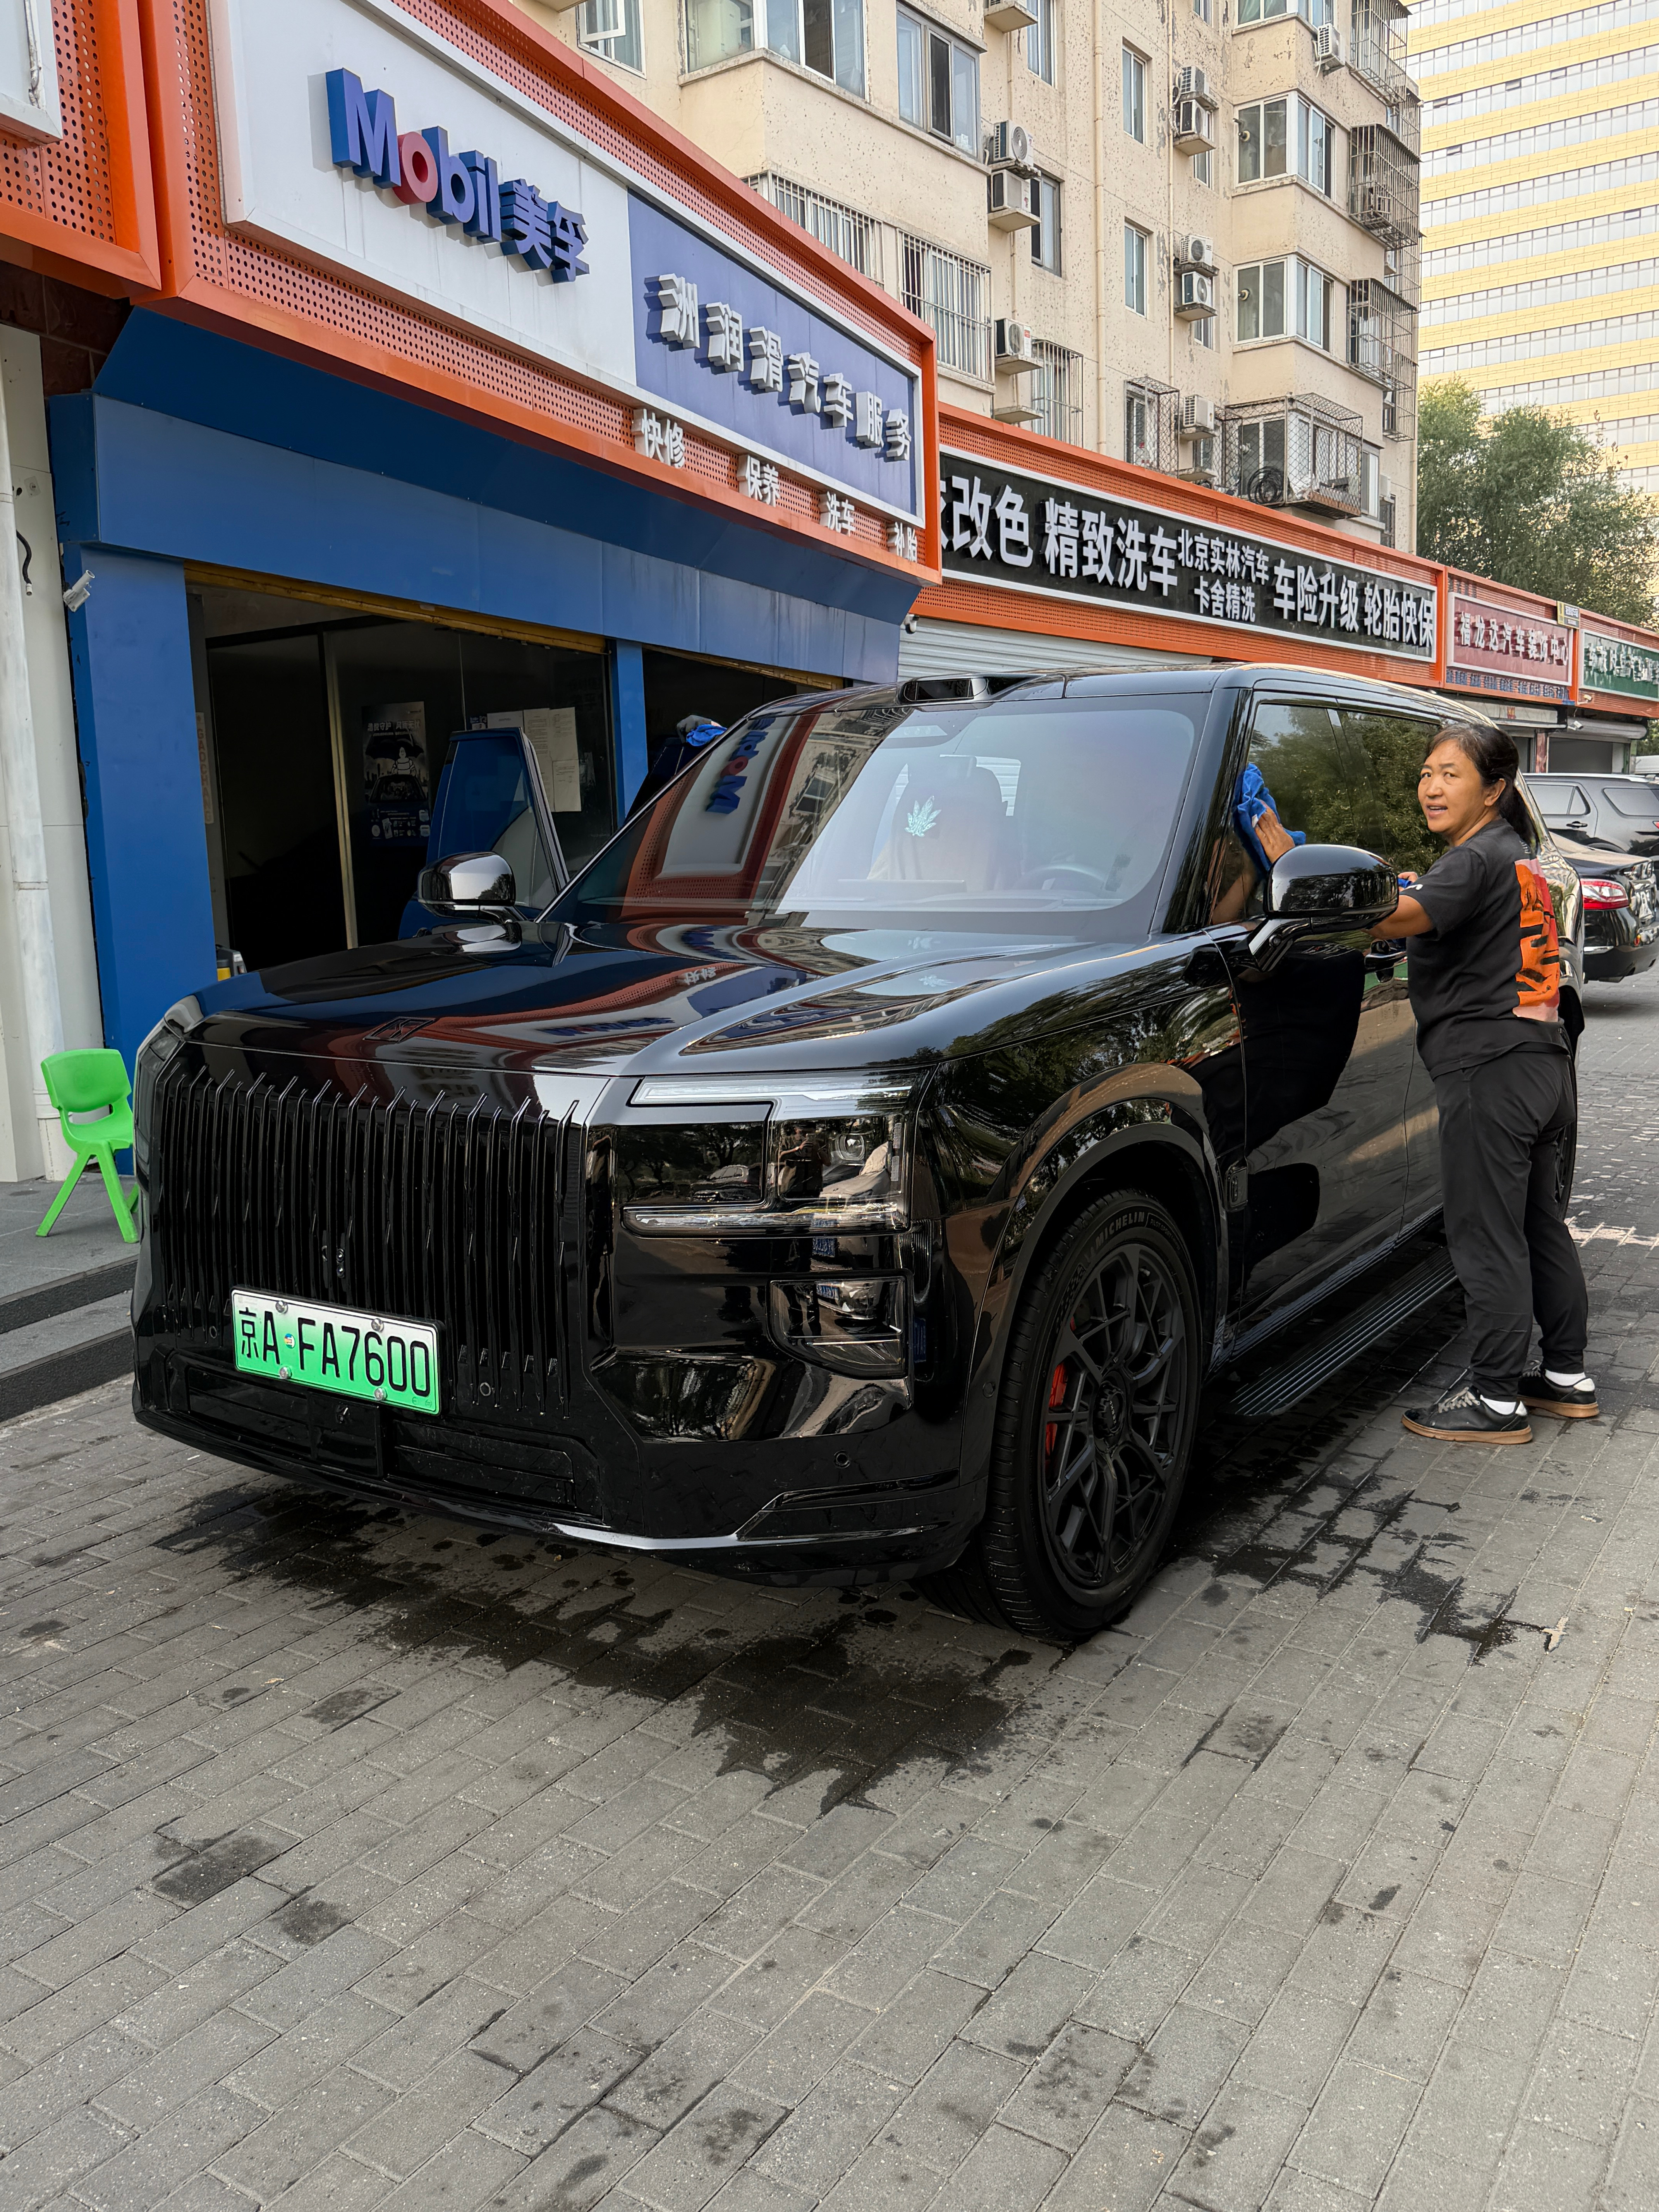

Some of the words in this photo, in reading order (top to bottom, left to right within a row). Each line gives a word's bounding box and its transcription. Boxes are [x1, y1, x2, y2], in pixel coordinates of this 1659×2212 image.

[326, 67, 502, 243] Mobil
[499, 179, 590, 283] 美孚
[654, 273, 912, 461] 洲润滑汽车服务
[634, 409, 685, 469] 快修
[738, 454, 781, 508] 保养
[820, 491, 856, 537] 洗车
[889, 522, 917, 563] 补胎
[1045, 497, 1178, 596] 精致洗车
[1273, 558, 1359, 633] 车险升级
[1364, 582, 1433, 648] 轮胎快保
[1178, 528, 1269, 585] 北京实林汽车
[1194, 575, 1255, 622] 卡舍精洗
[1095, 1211, 1145, 1250] MICHELIN
[297, 1317, 431, 1396] FA7600
